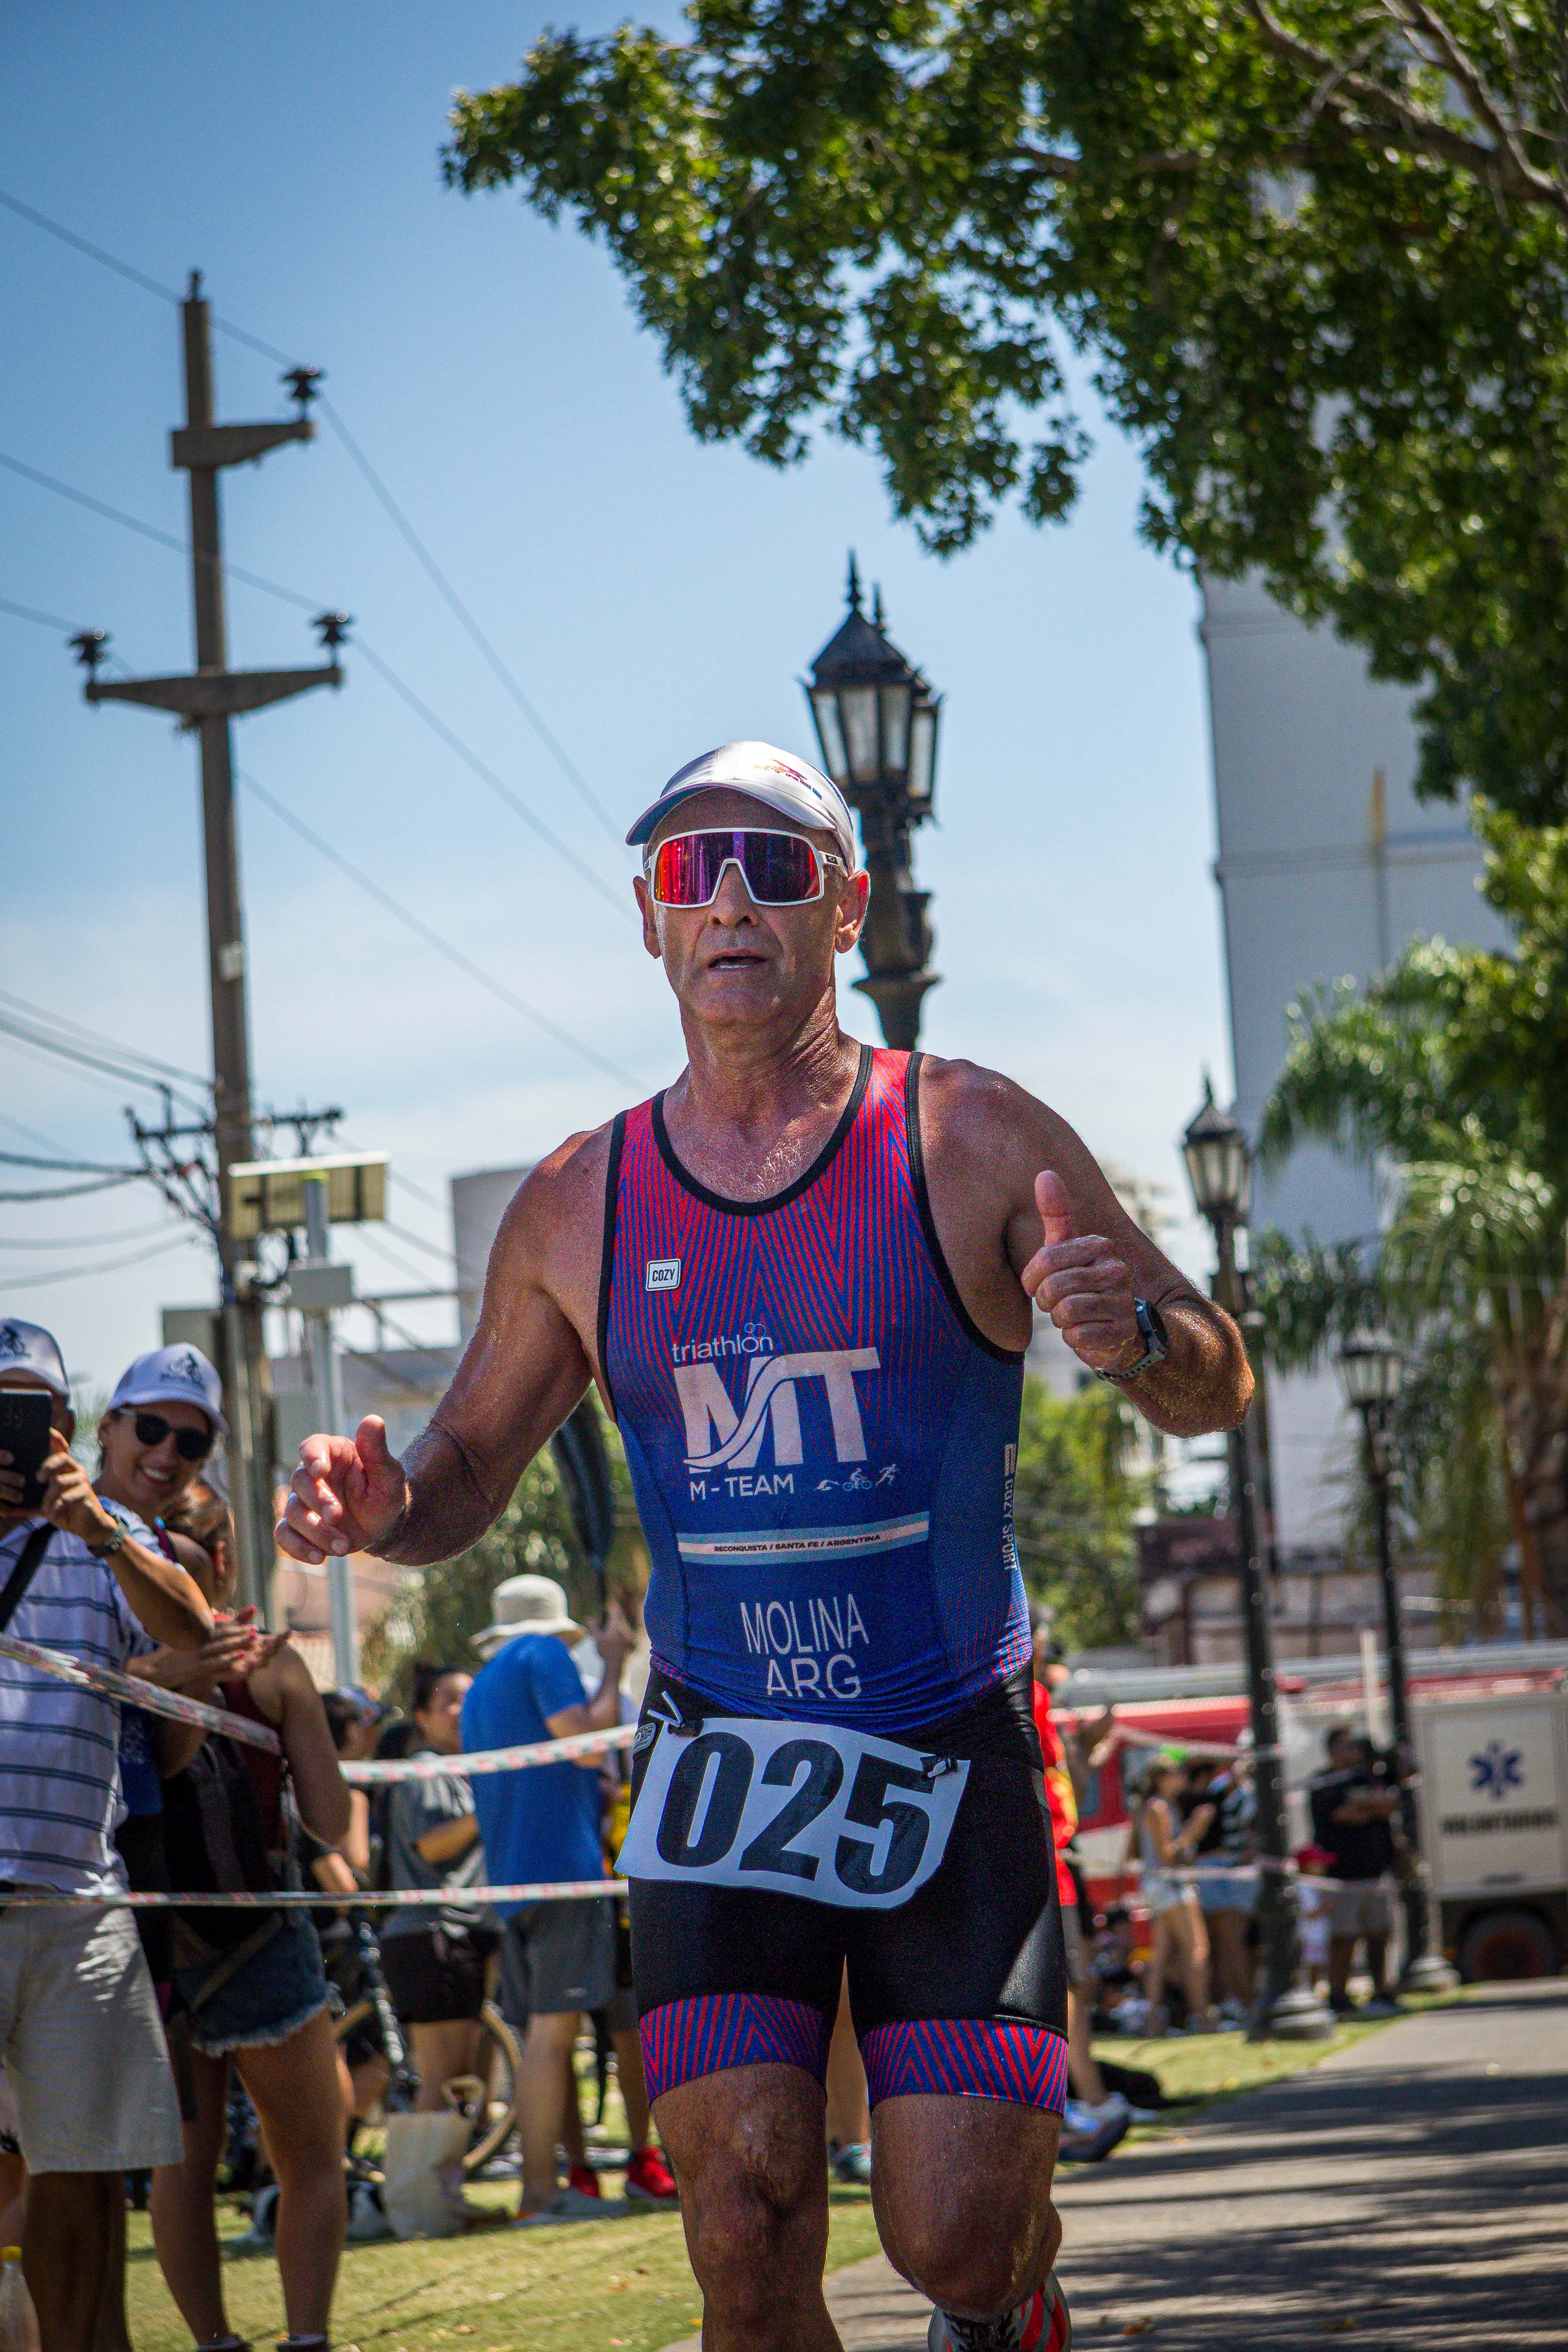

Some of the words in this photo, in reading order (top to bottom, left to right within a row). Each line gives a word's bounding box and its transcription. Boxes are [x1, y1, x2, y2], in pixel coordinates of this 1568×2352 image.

[652, 1268, 675, 1282] COZY
[672, 1335, 774, 1362] triathlon
[674, 1347, 880, 1474] MT
[826, 1535, 881, 1547] ARGENTINA
[740, 1594, 869, 1654] MOLINA
[767, 1654, 861, 1698] ARG
[656, 1731, 933, 1895] 025
